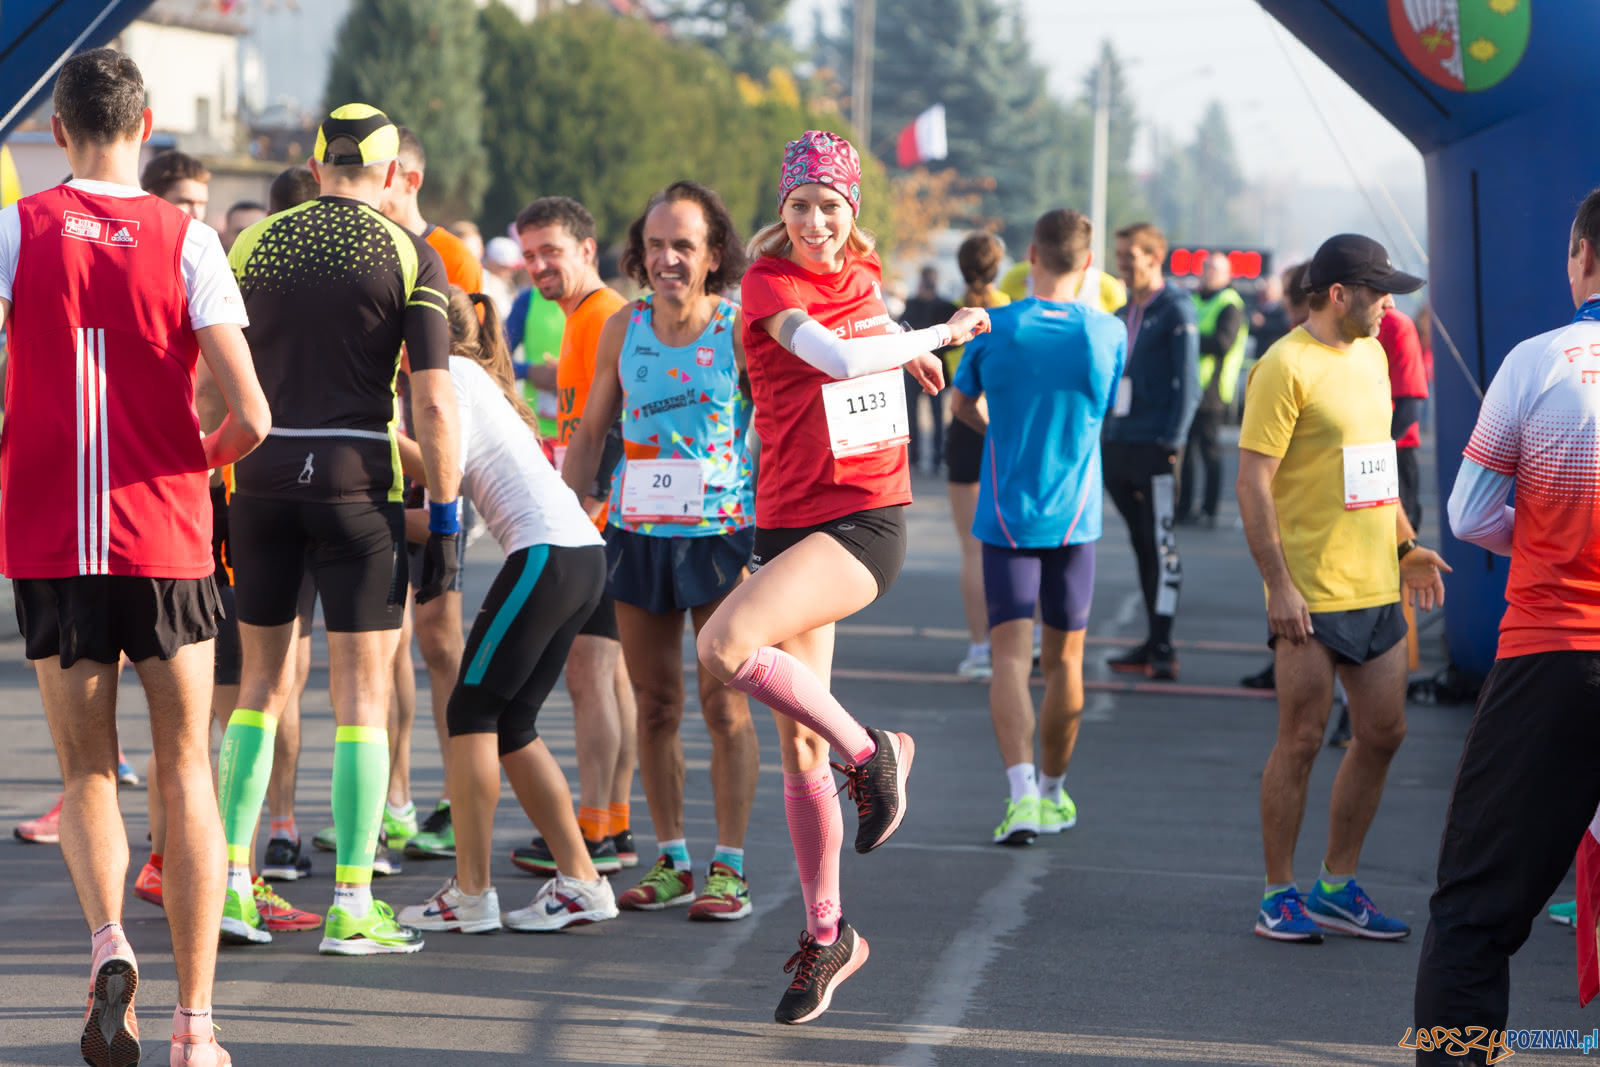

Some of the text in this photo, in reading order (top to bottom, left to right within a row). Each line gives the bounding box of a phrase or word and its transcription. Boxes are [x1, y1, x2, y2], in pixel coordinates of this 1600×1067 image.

[846, 391, 887, 415] 1133
[1361, 457, 1386, 475] 1140
[652, 473, 672, 488] 20
